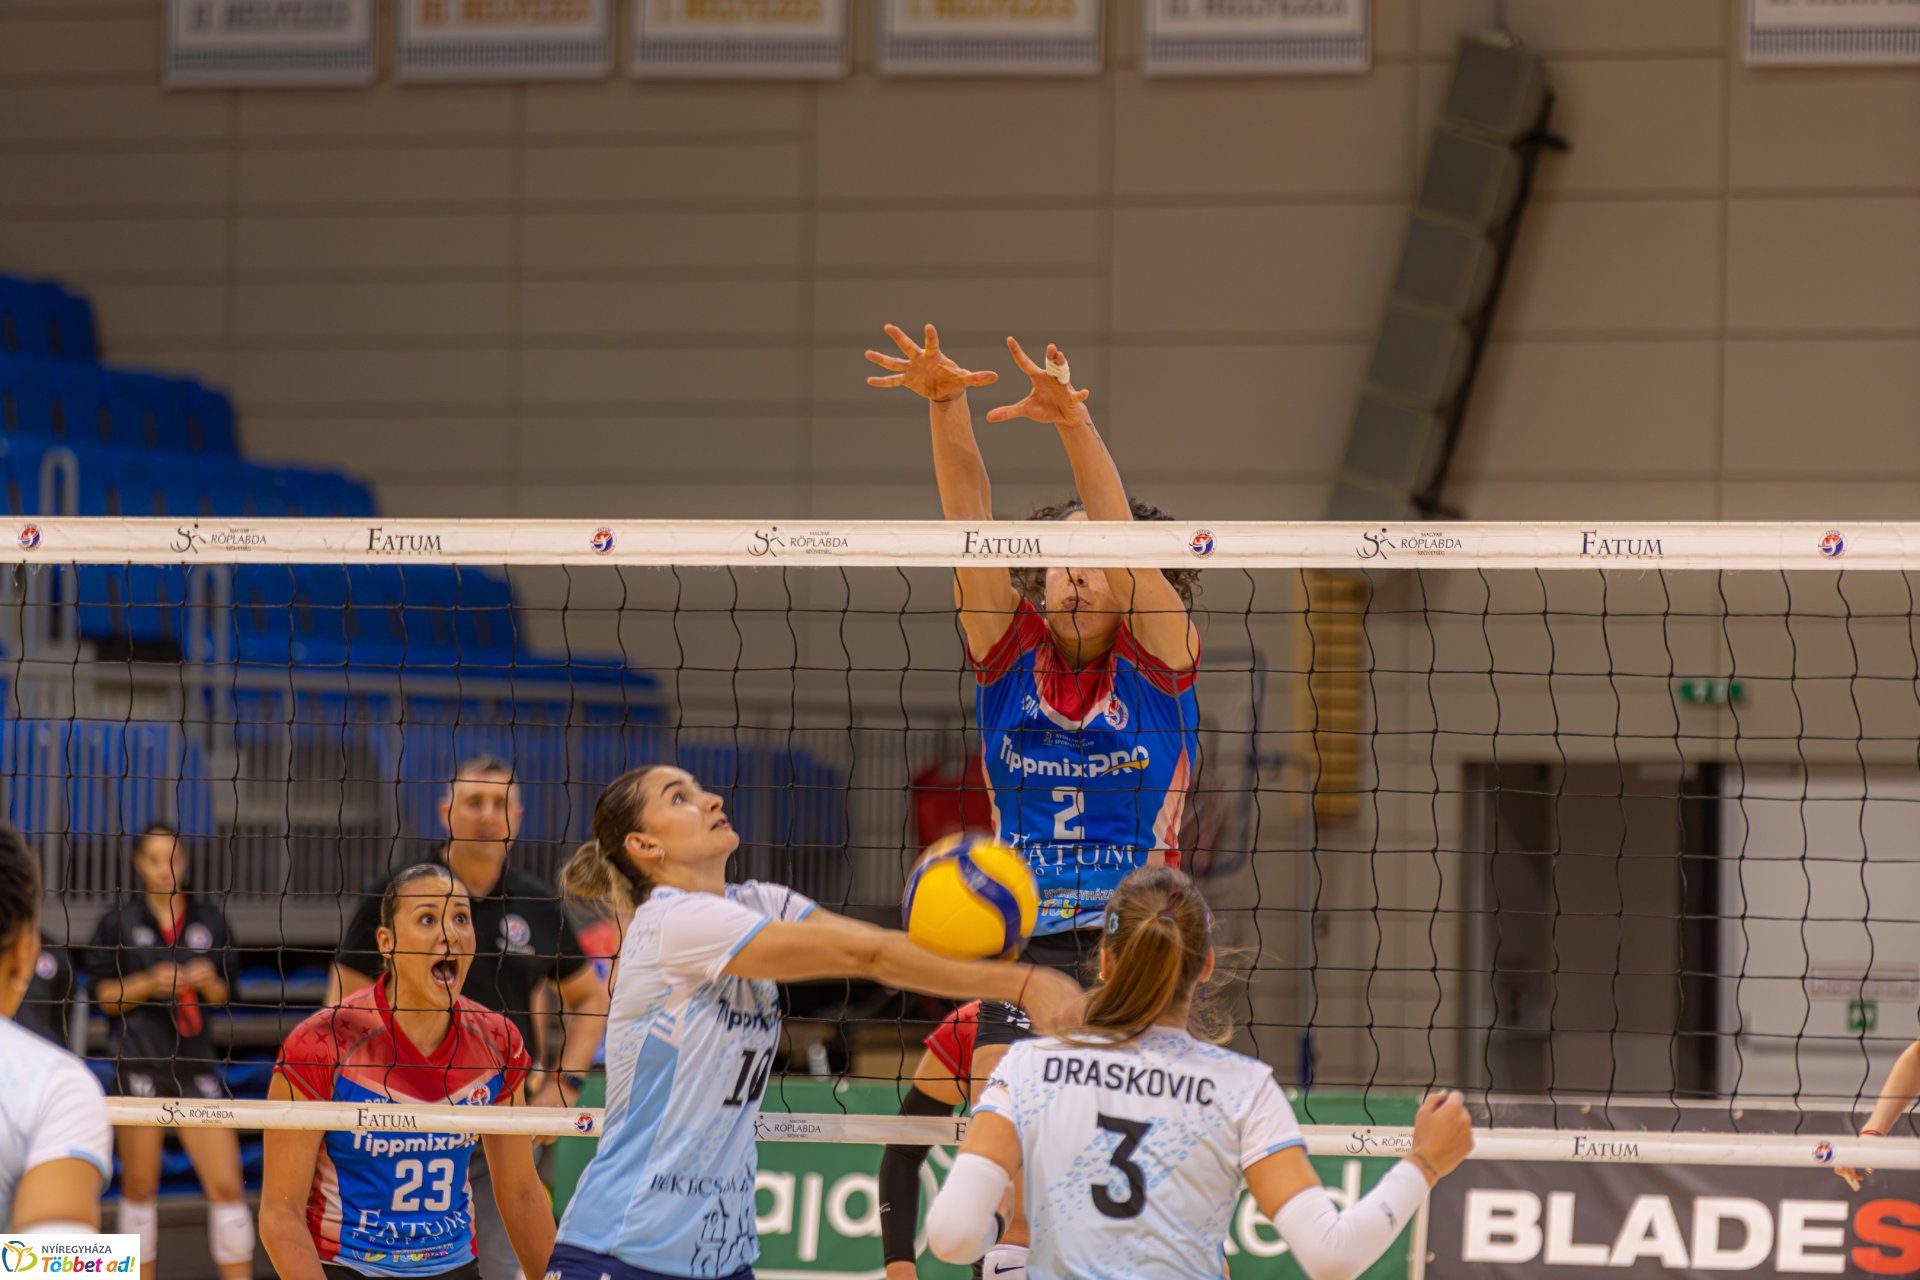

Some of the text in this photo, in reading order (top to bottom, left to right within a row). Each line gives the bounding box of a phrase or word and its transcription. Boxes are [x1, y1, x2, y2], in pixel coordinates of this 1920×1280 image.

[211, 532, 267, 544] RÖPLABDA
[367, 526, 441, 551] FATUM
[790, 535, 848, 548] RÖPLABDA
[962, 528, 1042, 554] FATUM
[1401, 536, 1462, 549] RÖPLABDA
[1580, 529, 1663, 555] FATUM
[1000, 734, 1149, 778] TippmixPRO
[1052, 786, 1086, 840] 2
[723, 1048, 772, 1106] 10
[1043, 1056, 1216, 1107] DRASKOVIC
[189, 1108, 234, 1119] RÖPLABDA
[356, 1107, 417, 1127] FATUM
[774, 1122, 821, 1133] RÖPLABDA
[1381, 1136, 1412, 1147] RÖPLA
[1573, 1134, 1639, 1157] FATUM
[1091, 1111, 1153, 1220] 3
[390, 1158, 455, 1212] 23
[352, 1208, 468, 1239] FATUM
[1461, 1187, 1920, 1275] BLADES
